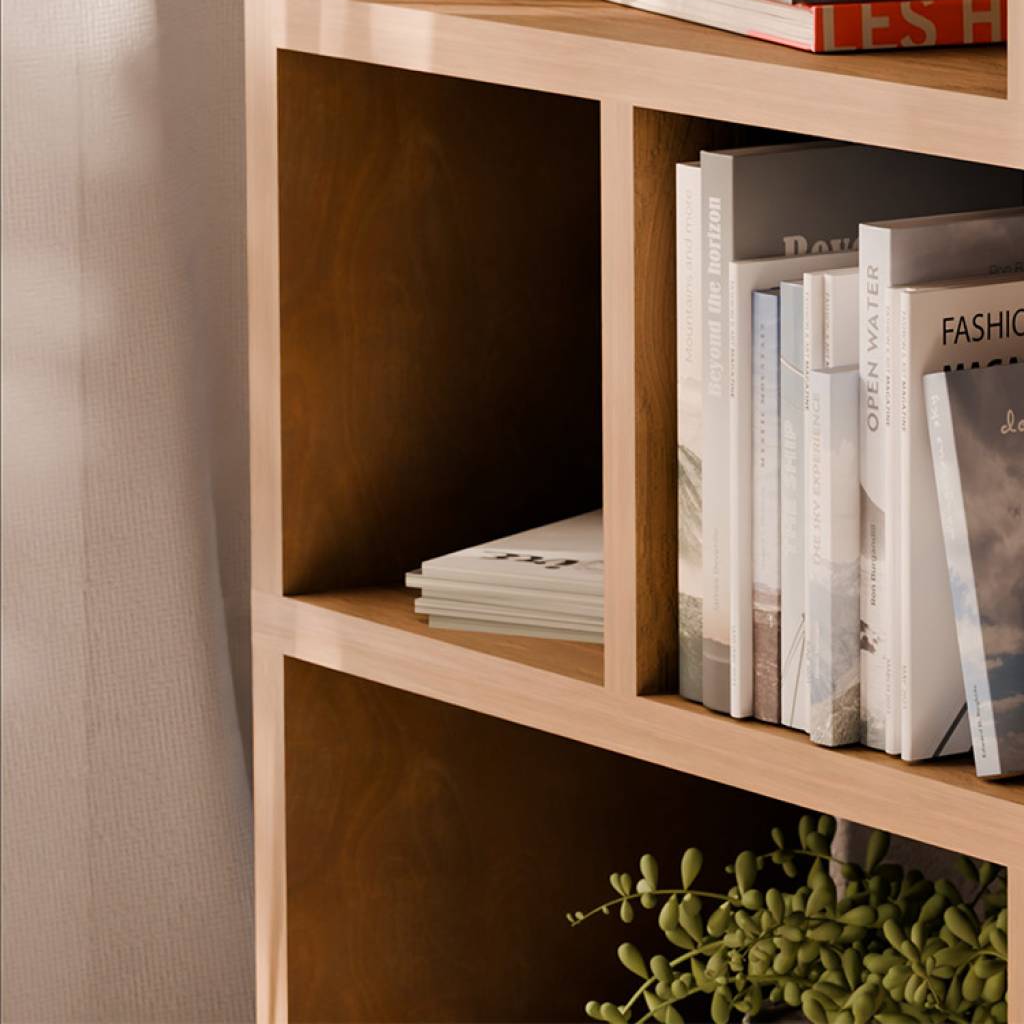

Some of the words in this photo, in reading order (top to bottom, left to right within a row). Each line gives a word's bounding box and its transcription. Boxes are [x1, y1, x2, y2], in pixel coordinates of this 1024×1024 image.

[823, 1, 937, 49] LES
[685, 189, 694, 235] more
[708, 196, 722, 275] horizon
[684, 238, 694, 269] and
[684, 274, 694, 364] Mountains
[708, 281, 722, 314] the
[866, 264, 879, 352] WATER
[708, 320, 723, 398] Beyond
[866, 361, 879, 432] OPEN
